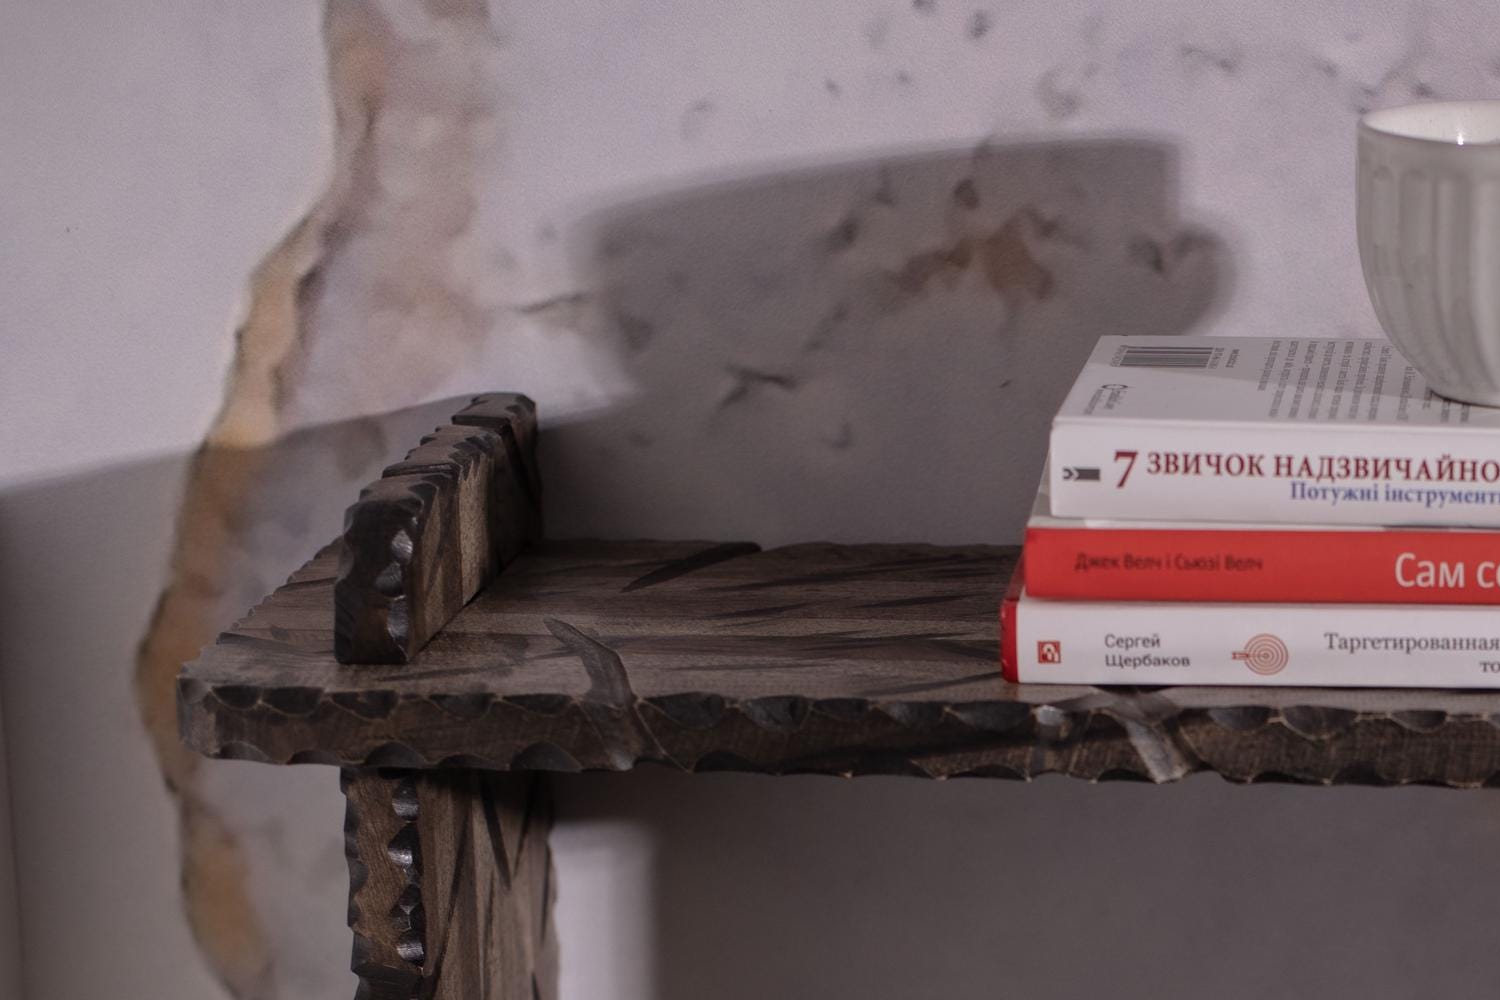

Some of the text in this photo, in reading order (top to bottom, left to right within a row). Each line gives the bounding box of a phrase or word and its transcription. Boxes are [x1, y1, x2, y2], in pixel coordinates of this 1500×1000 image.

[1113, 450, 1139, 488] 7
[1146, 452, 1265, 478] ЗВИЧОК
[1274, 453, 1500, 485] НАДЗВИЧАЙНО
[1291, 481, 1378, 506] Потужні
[1075, 552, 1120, 572] Джек
[1124, 553, 1161, 570] Велч
[1174, 554, 1220, 571] Сьюзі
[1225, 554, 1264, 571] Велч
[1394, 552, 1465, 589] Сам
[1104, 633, 1161, 652] Сергей
[1324, 632, 1500, 655] Таргетированная
[1104, 653, 1191, 669] Щербаков
